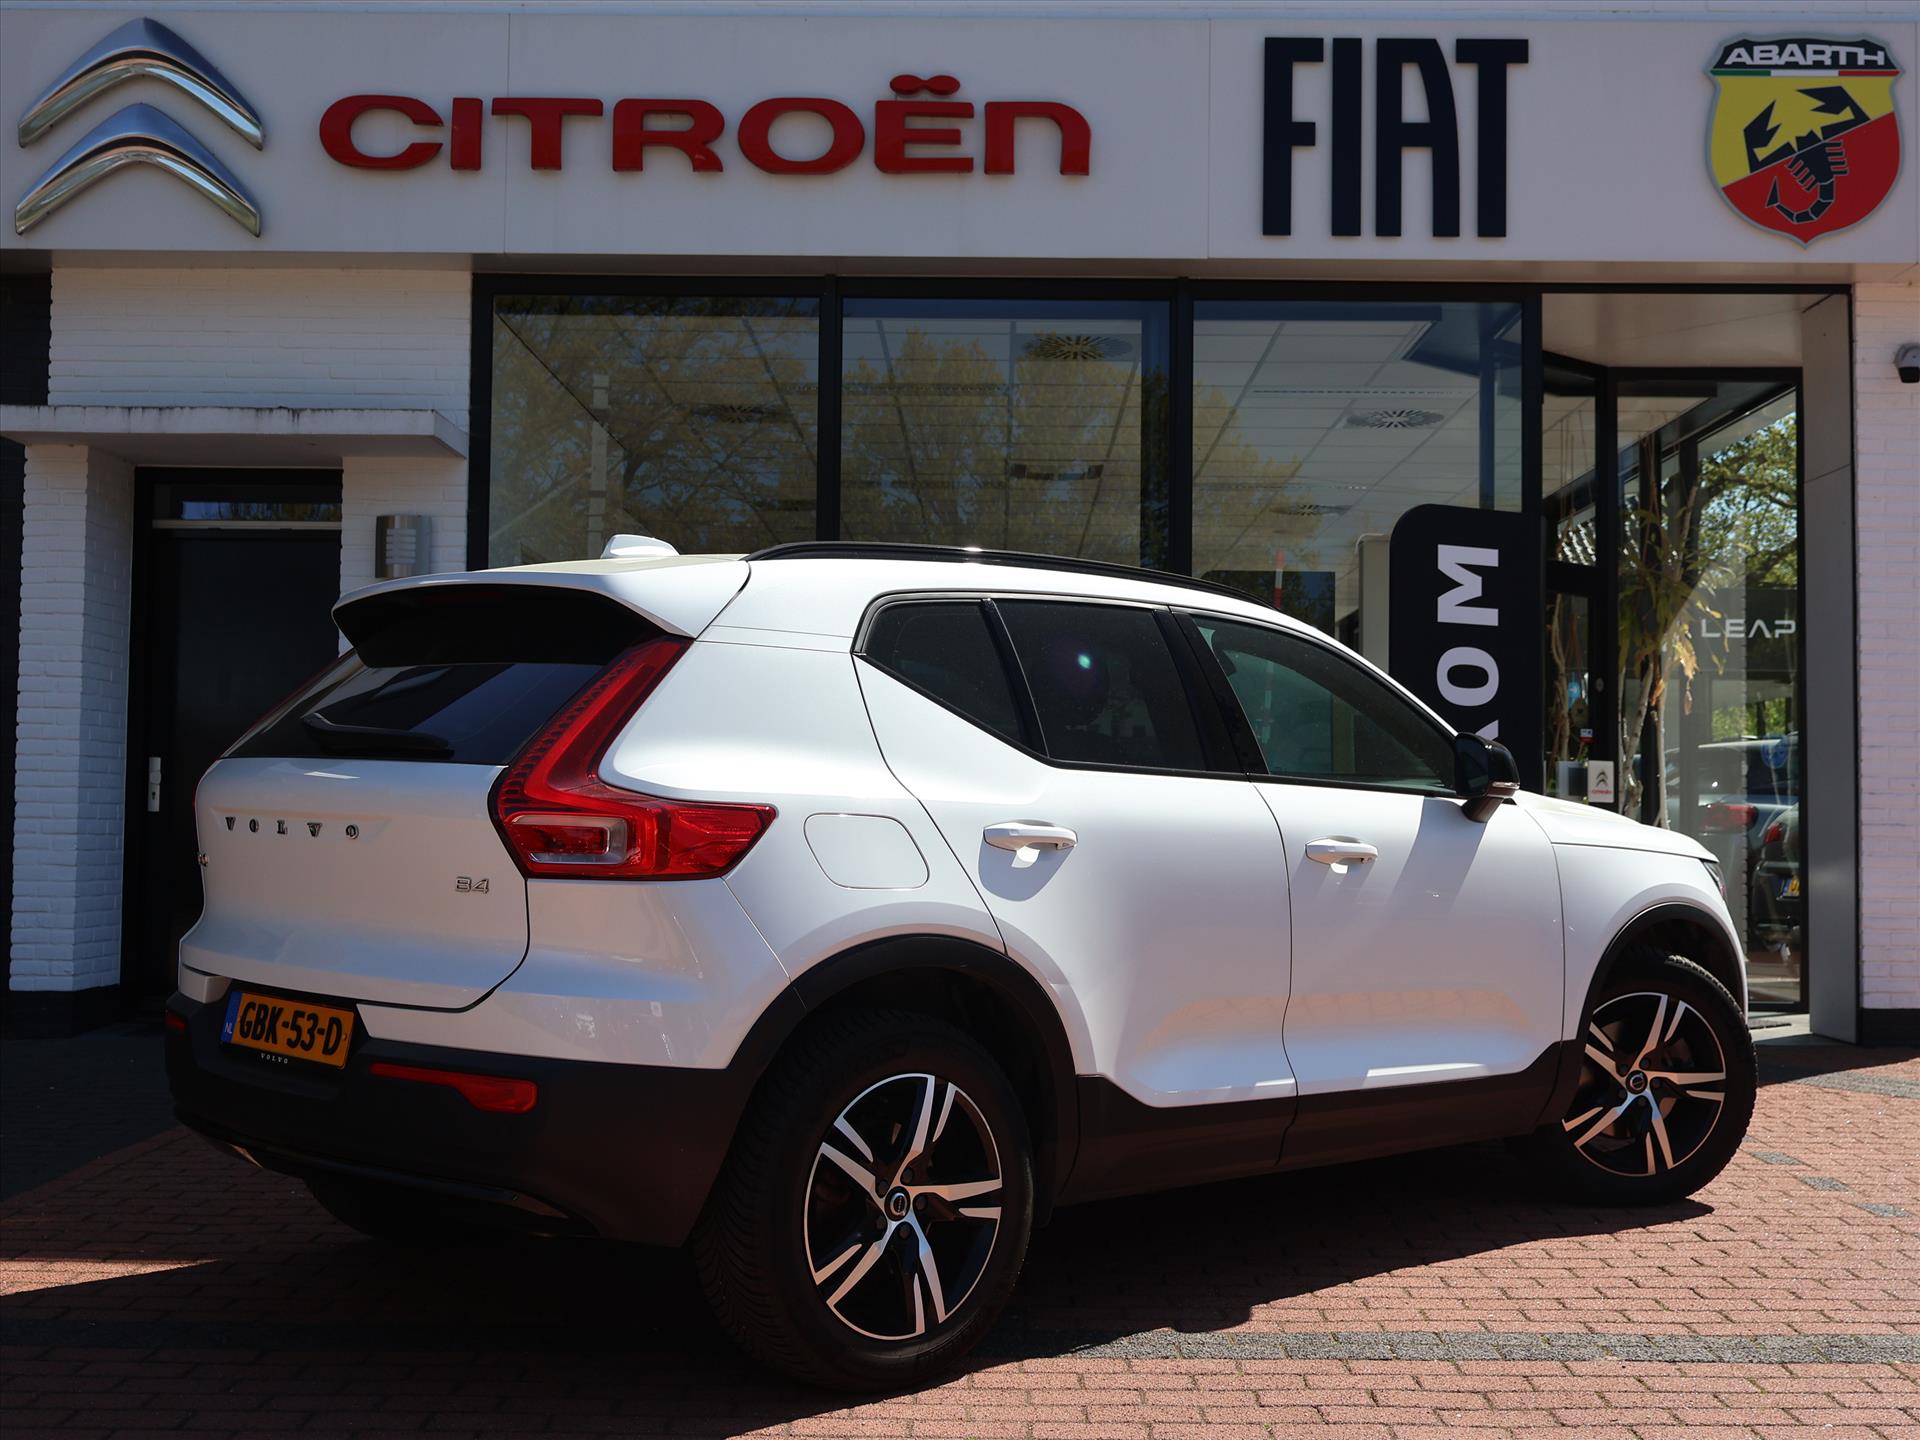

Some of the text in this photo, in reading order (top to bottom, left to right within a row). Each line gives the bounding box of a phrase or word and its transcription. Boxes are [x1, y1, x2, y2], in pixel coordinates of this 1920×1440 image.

[1724, 43, 1885, 66] ABARTH
[319, 74, 1092, 176] CITROËN
[1262, 37, 1529, 237] FIAT
[1701, 618, 1796, 639] LEAP
[1436, 543, 1499, 741] OM
[225, 816, 359, 840] VOLVO
[455, 876, 490, 894] B4
[239, 1001, 343, 1056] GBK-53-D
[260, 1052, 288, 1064] VOLVO
